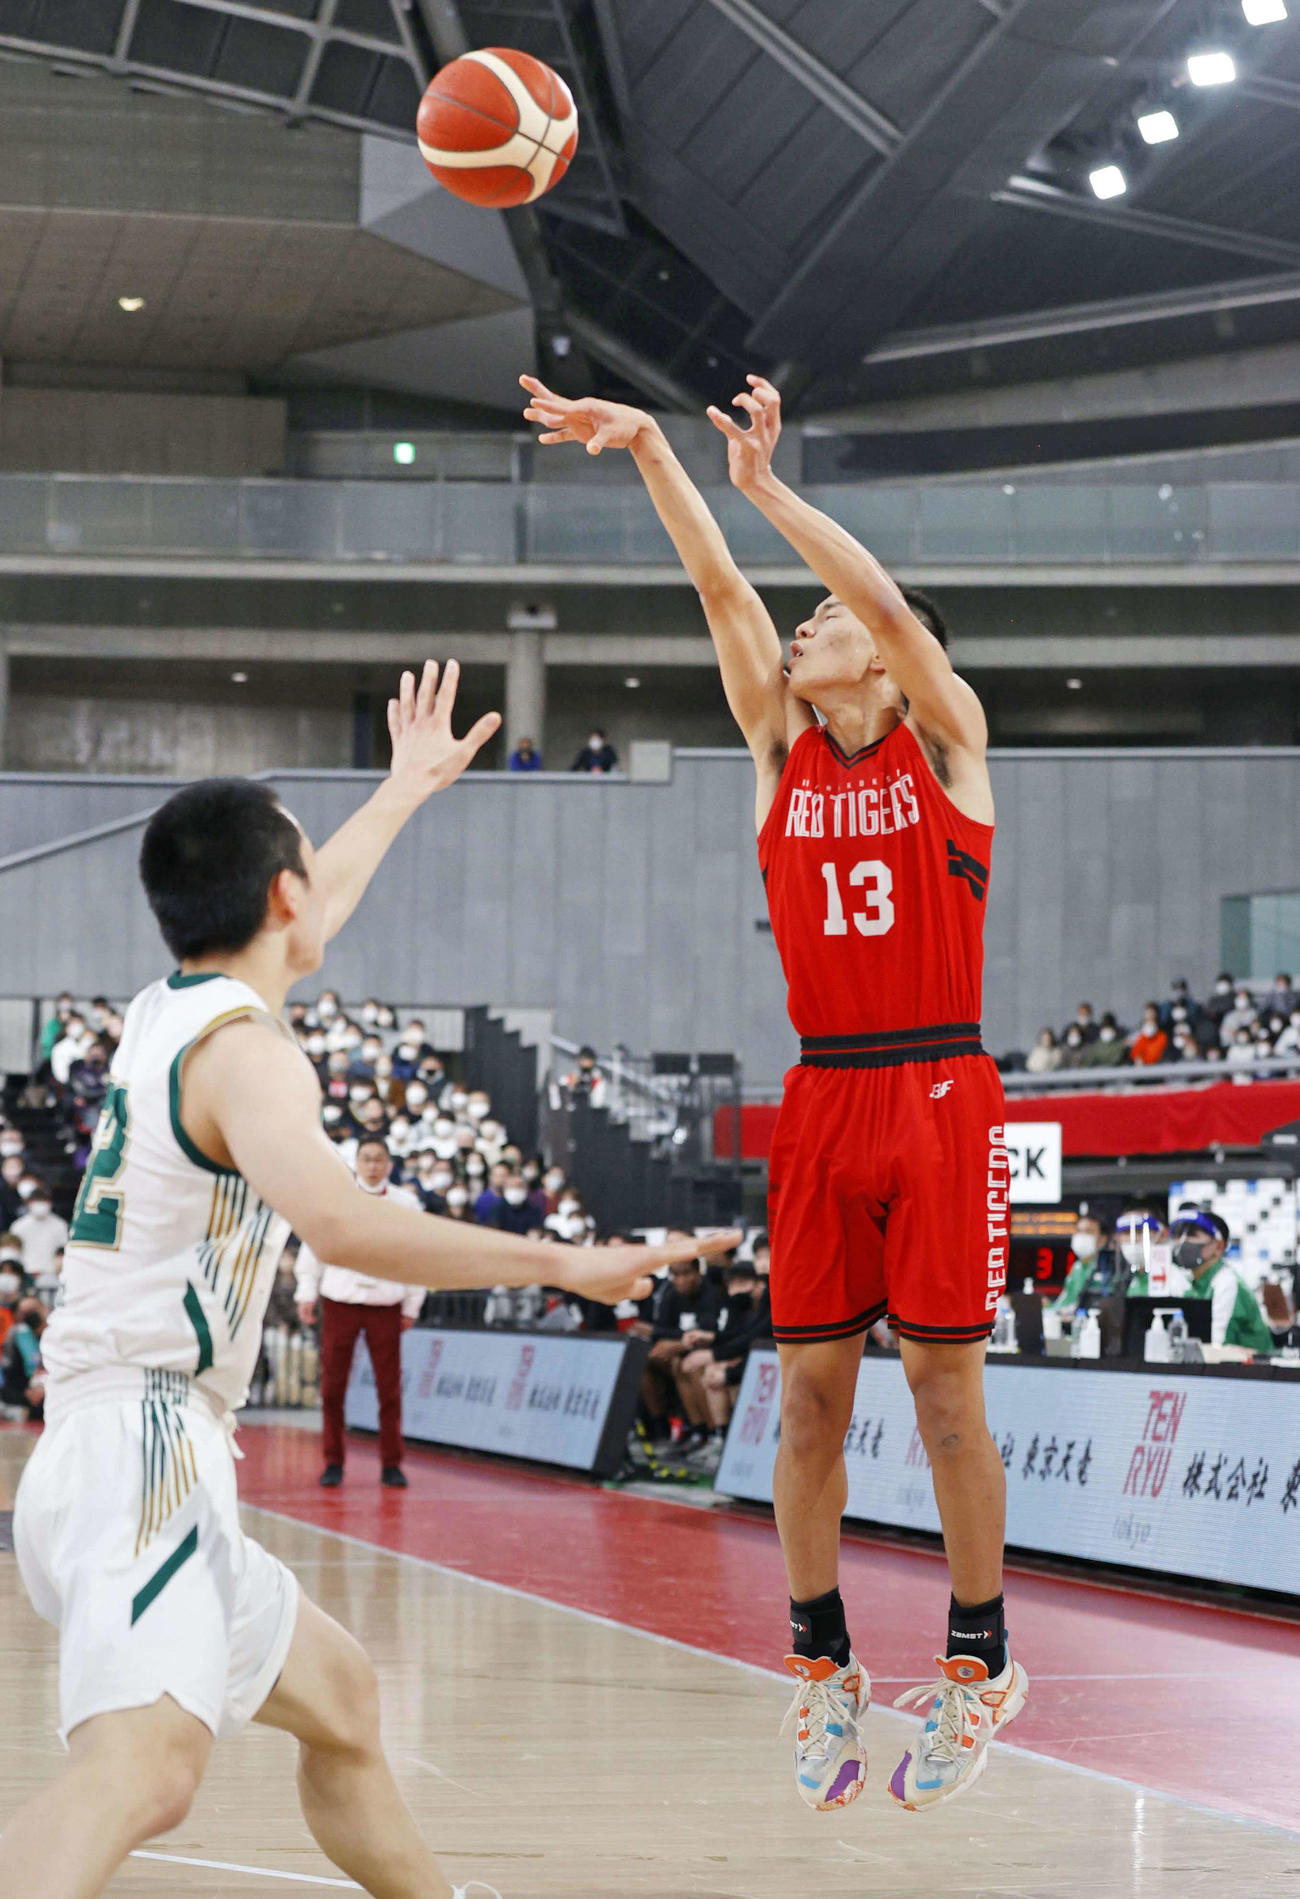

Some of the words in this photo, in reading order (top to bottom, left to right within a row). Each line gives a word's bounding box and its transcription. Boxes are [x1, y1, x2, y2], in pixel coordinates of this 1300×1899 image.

[784, 788, 824, 838] RED
[829, 773, 920, 838] TIGERS
[821, 860, 895, 937] 13
[1143, 1390, 1187, 1444] TEN
[1122, 1445, 1172, 1498] RYU
[1182, 1451, 1270, 1506] 株式会社
